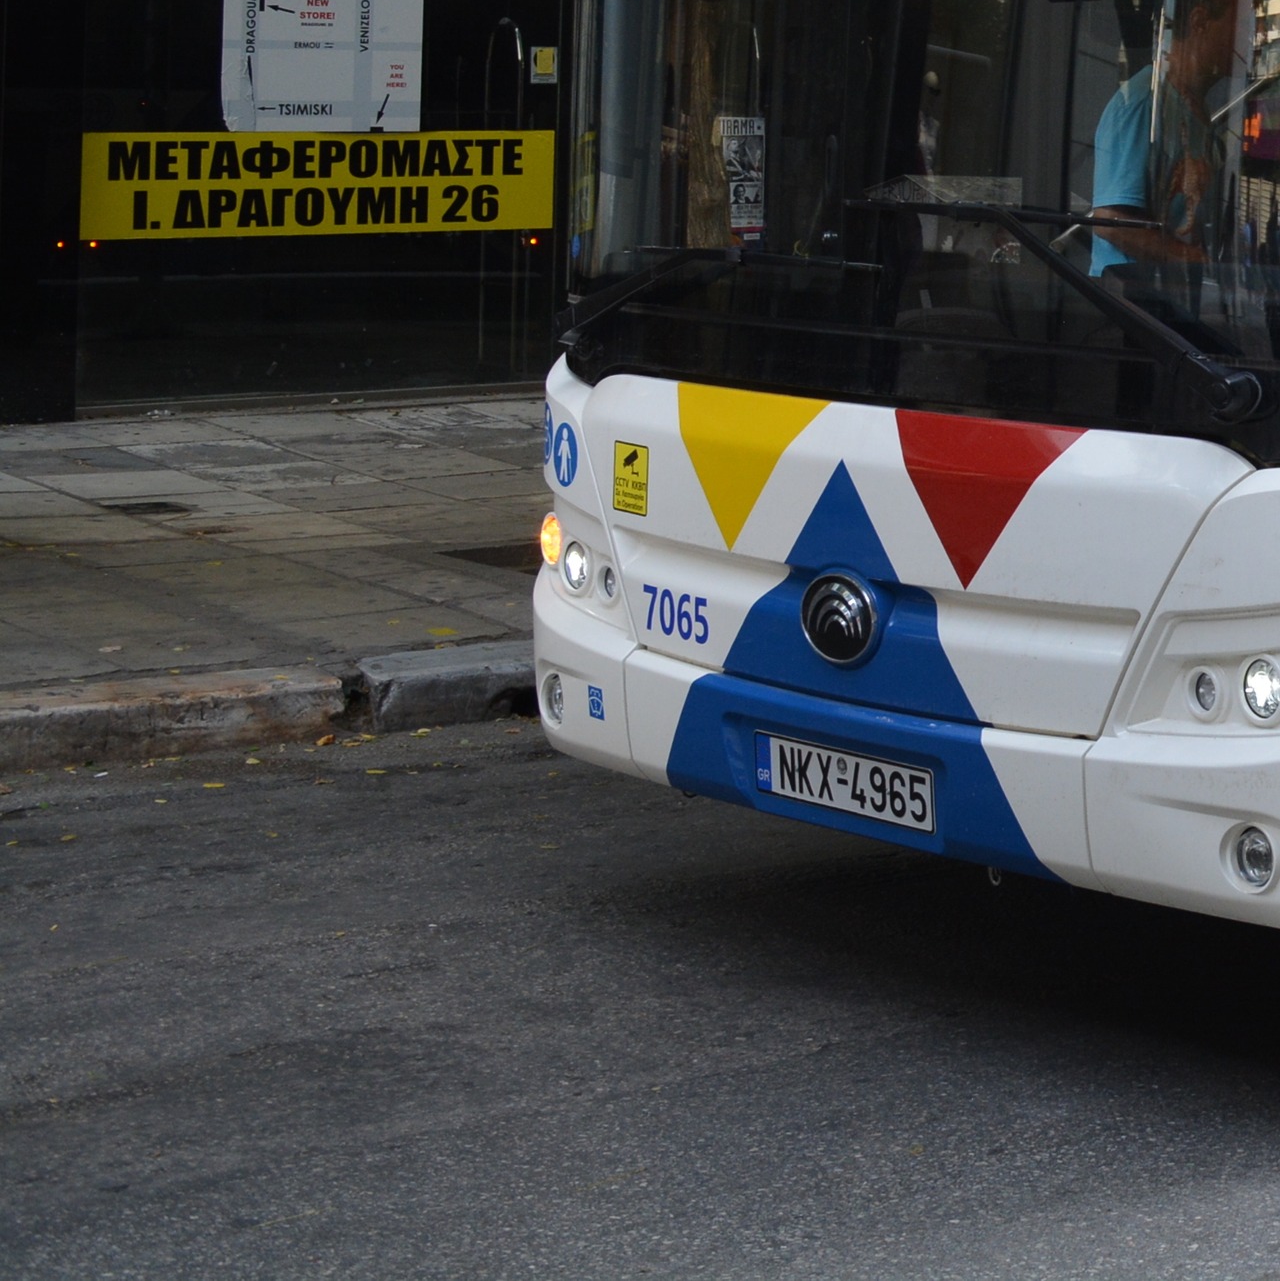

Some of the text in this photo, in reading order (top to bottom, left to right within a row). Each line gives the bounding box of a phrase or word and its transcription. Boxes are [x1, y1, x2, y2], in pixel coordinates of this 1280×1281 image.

[307, 0, 330, 7] NEW
[299, 11, 336, 20] STORE!
[293, 41, 321, 49] ERMOU
[278, 103, 333, 116] TSIMISKI
[107, 139, 523, 181] ΜΕΤΑΦΕΡΟΜΑΣΤΕ
[172, 186, 429, 230] ΔΡΑΓΟΥΜΗ
[442, 184, 500, 223] 26
[642, 583, 710, 644] 7065
[757, 768, 770, 782] GR
